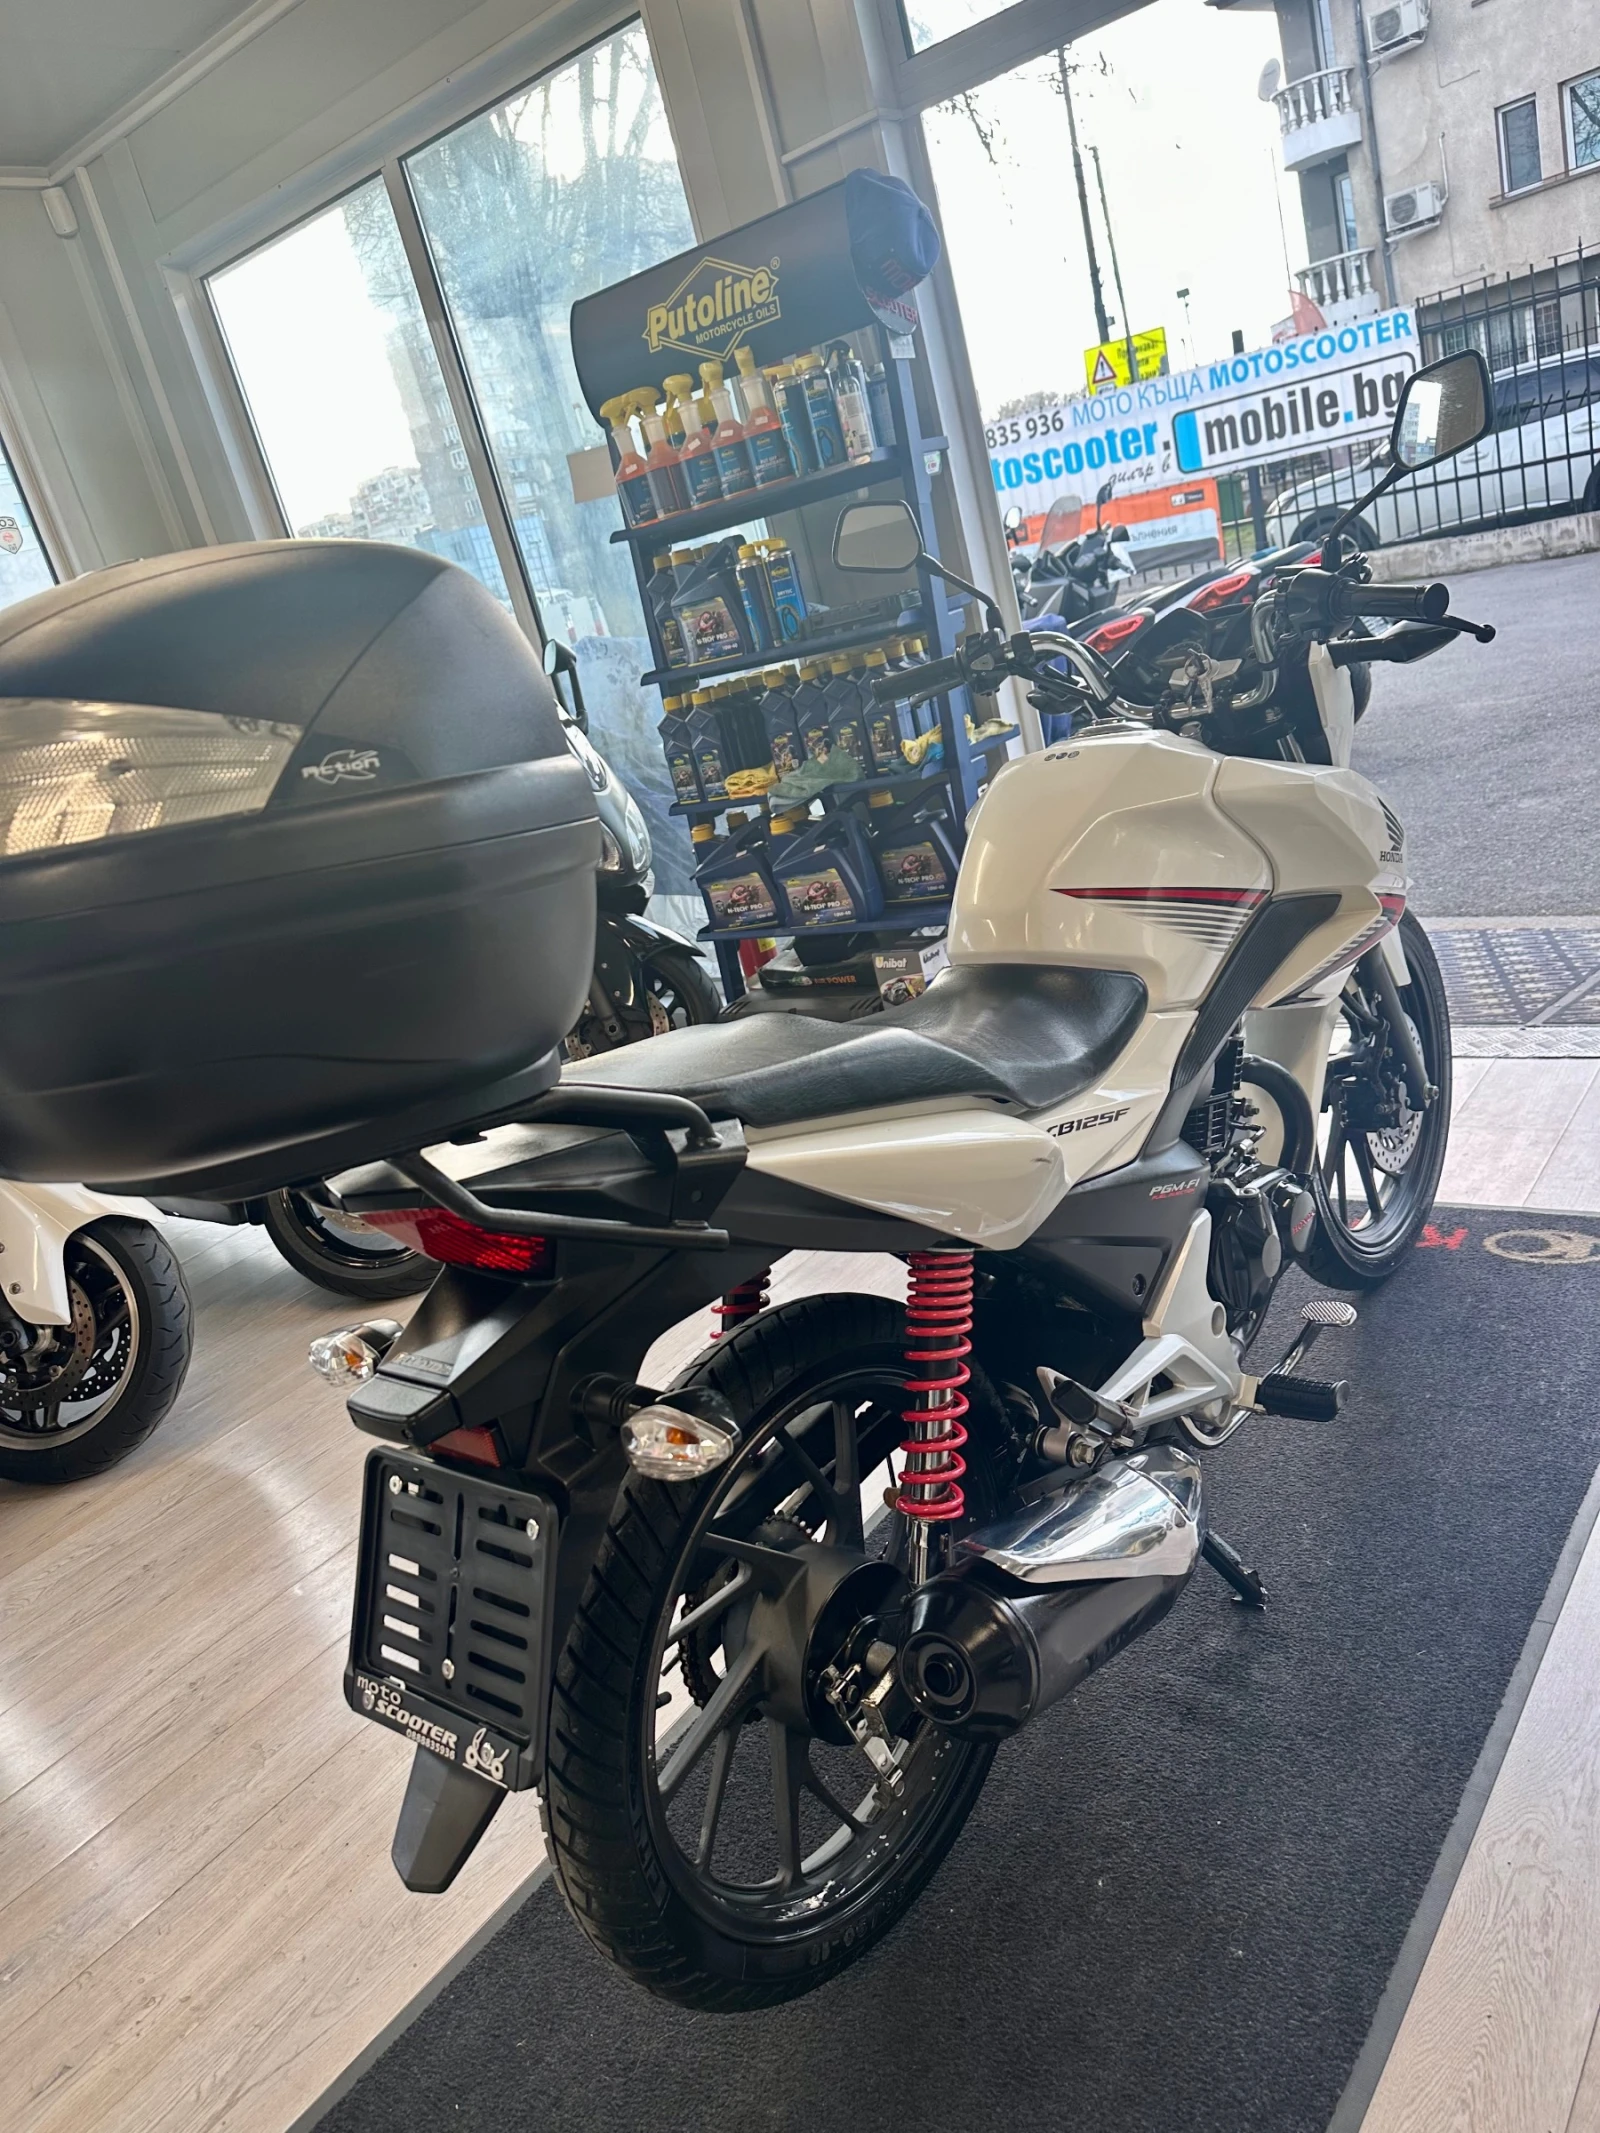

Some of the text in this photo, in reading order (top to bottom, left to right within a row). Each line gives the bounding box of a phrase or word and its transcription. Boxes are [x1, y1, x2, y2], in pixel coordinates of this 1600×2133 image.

[650, 271, 770, 348] Putoline
[696, 304, 777, 344] MOTORCYCLE OILS
[985, 421, 1021, 449] 835
[1025, 410, 1064, 439] 936
[1072, 391, 1132, 428] МОТО
[1138, 374, 1204, 410] КЪЩА
[1209, 311, 1412, 390] MOTOSCOOTER
[1204, 371, 1405, 455] mobile.bg
[716, 632, 728, 640] PRO
[1379, 850, 1403, 863] HONDA
[875, 956, 908, 969] Unibat
[1046, 1107, 1131, 1138] CB125F
[357, 1675, 401, 1705] moto
[375, 1699, 458, 1750] SCOOTER
